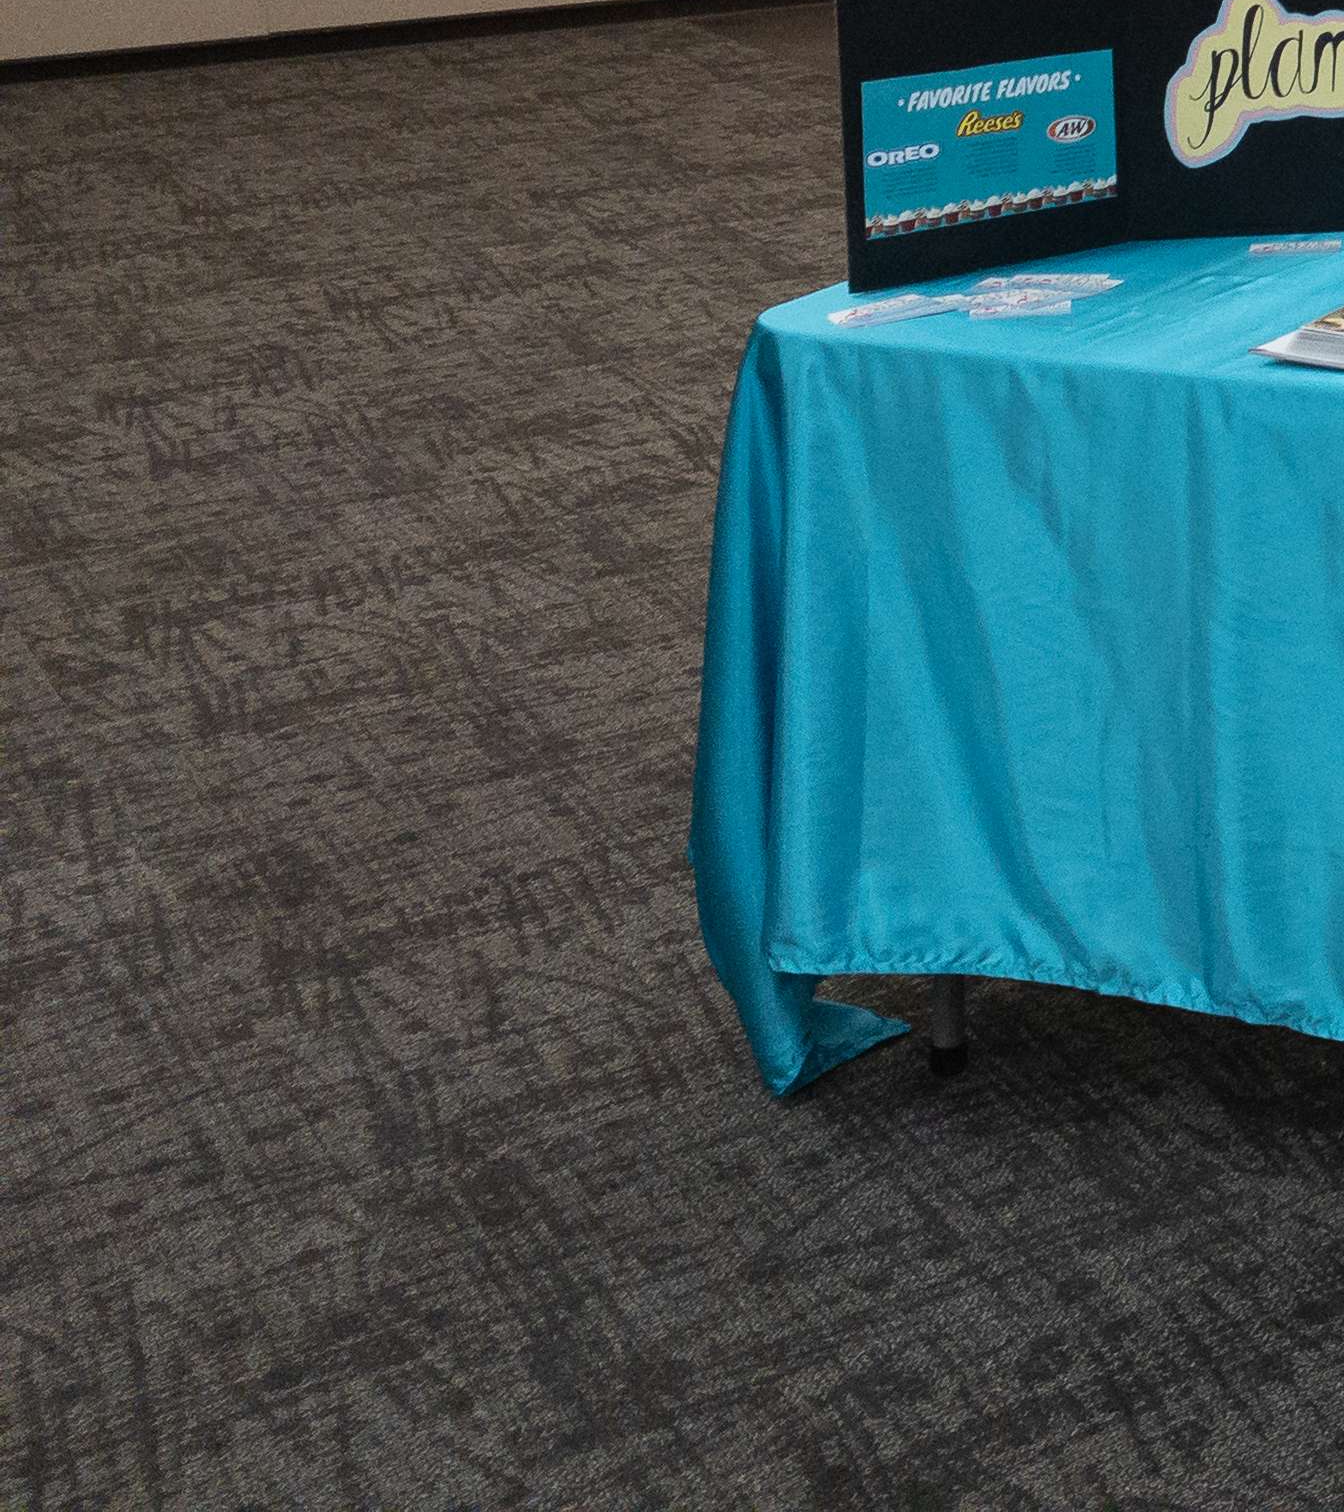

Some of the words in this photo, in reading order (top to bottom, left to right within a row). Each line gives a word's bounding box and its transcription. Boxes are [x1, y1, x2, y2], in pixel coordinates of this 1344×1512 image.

[907, 81, 991, 113] FAVORITE
[996, 70, 1072, 99] FLAVORS
[866, 143, 940, 168] OREO
